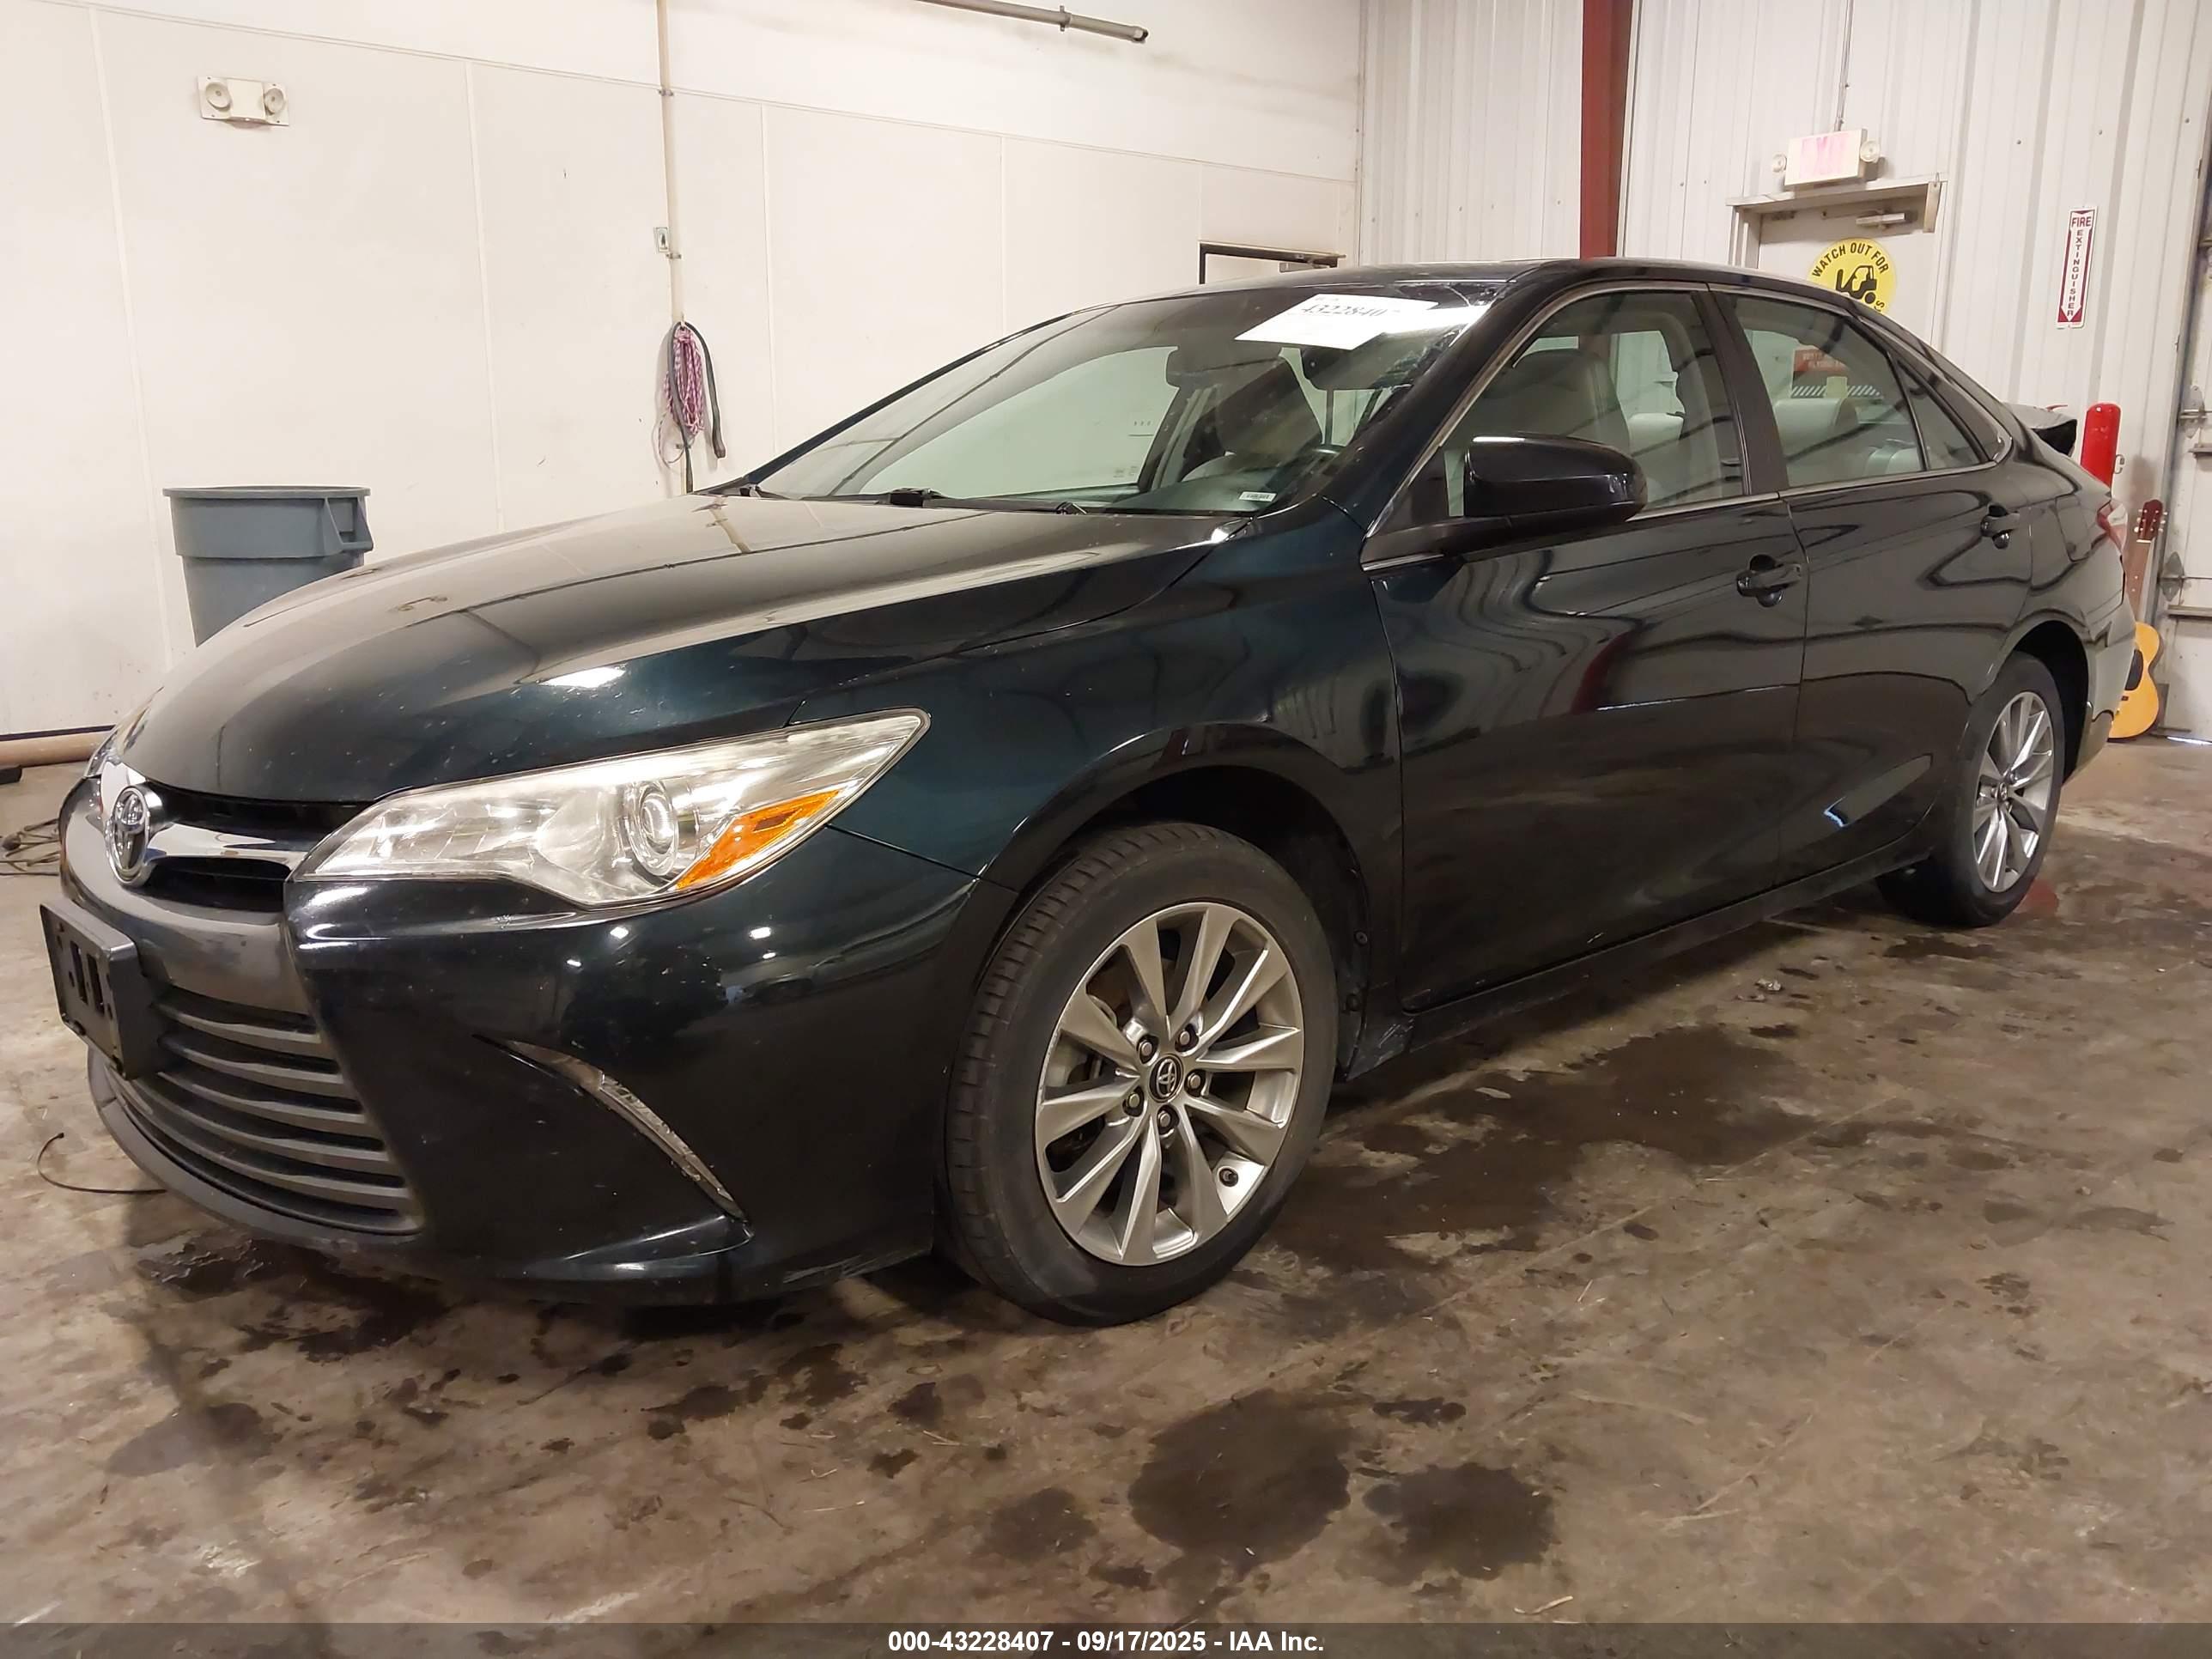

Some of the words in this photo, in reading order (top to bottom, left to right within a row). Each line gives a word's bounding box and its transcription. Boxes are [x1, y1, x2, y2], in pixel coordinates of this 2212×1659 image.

[2072, 216, 2092, 227] FIRE
[1812, 245, 1846, 276] WATCH
[1850, 242, 1872, 256] OUT
[1871, 251, 1888, 273] FOR
[2067, 229, 2084, 316] EXTINGUISHER
